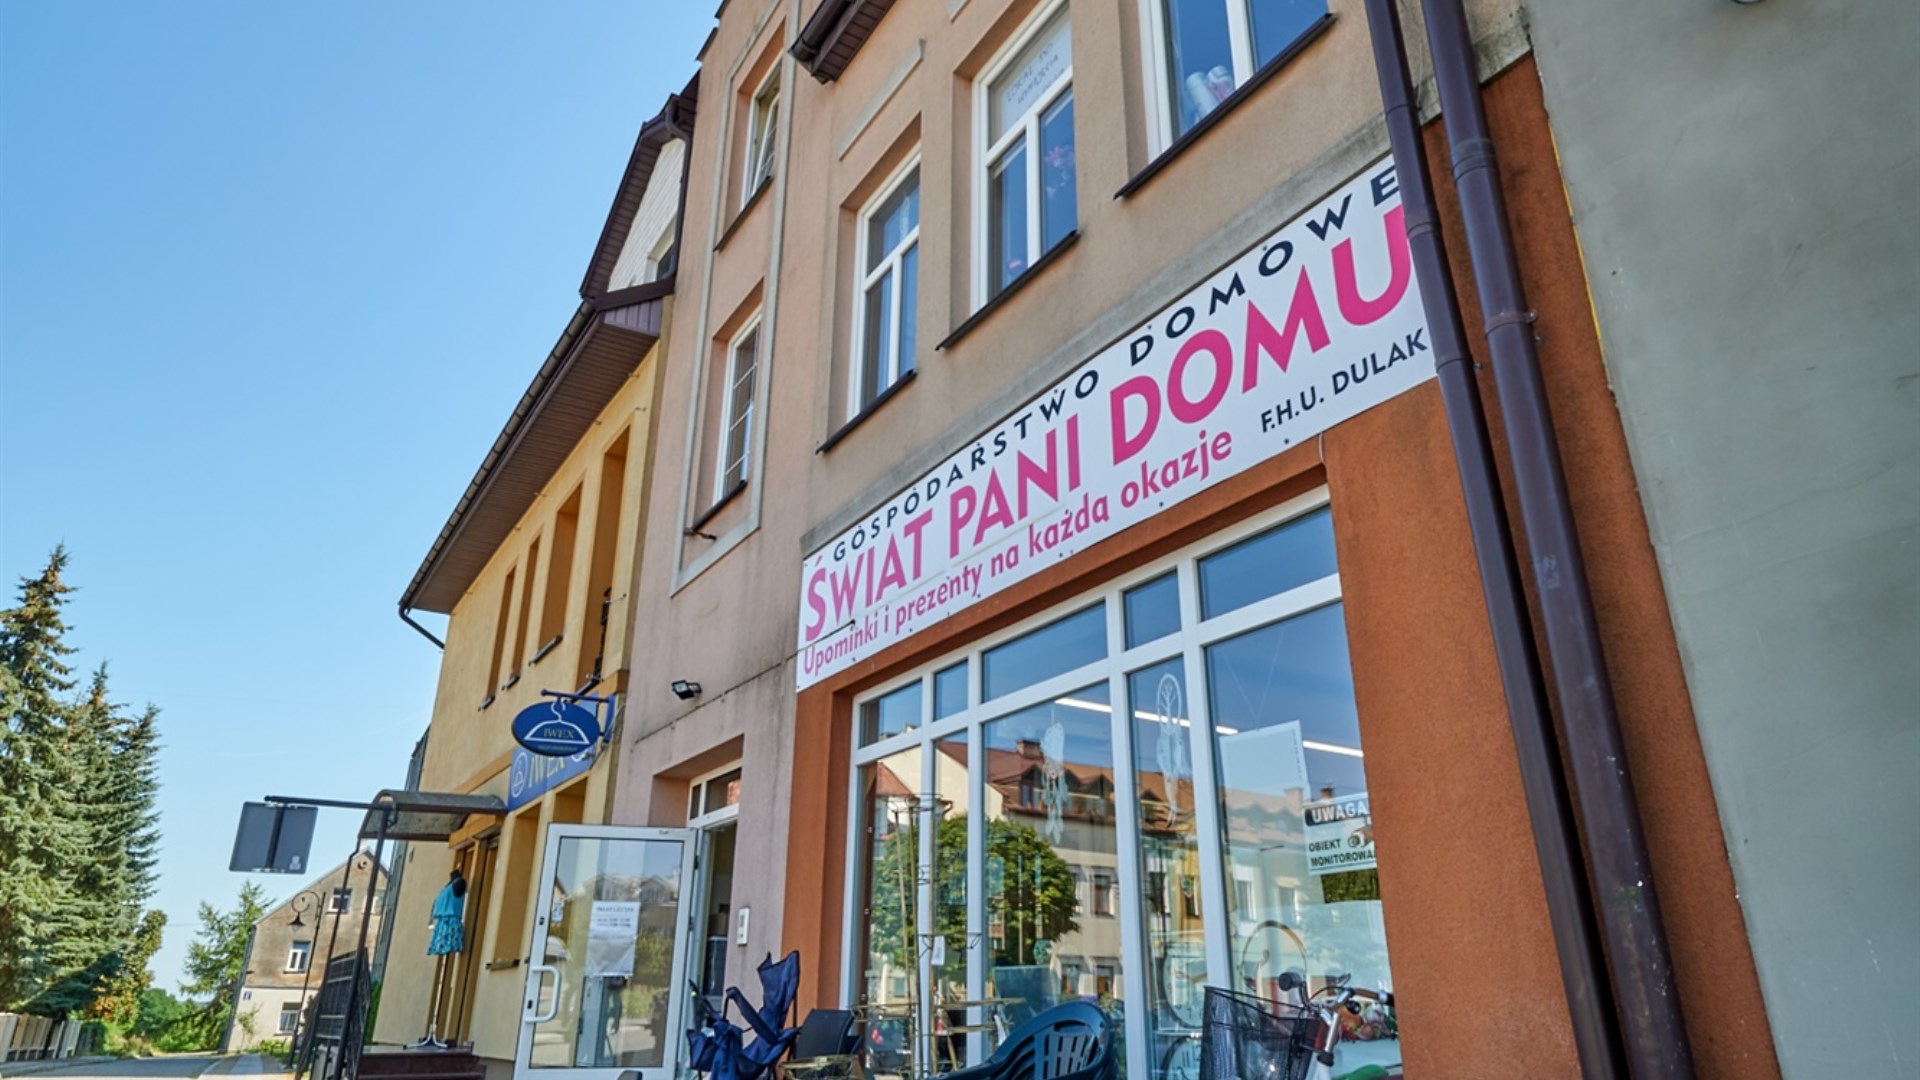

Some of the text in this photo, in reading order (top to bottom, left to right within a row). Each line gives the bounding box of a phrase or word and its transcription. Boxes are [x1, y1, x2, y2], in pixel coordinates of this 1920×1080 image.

[832, 165, 1400, 562] GOSPODARSTWO DOMOWE
[1261, 327, 1428, 433] F.H.U. DULAK
[805, 204, 1411, 642] ŚWIAT PANI DOMU
[804, 610, 878, 676] Upominki
[883, 606, 889, 632] i
[895, 564, 983, 635] prezenty
[991, 544, 1019, 577] na
[1121, 429, 1233, 509] okazje
[543, 727, 574, 739] IWEX
[1311, 801, 1368, 823] UWAGA
[1308, 839, 1341, 852] OBIEKT
[1310, 849, 1375, 867] MONITOROWA
